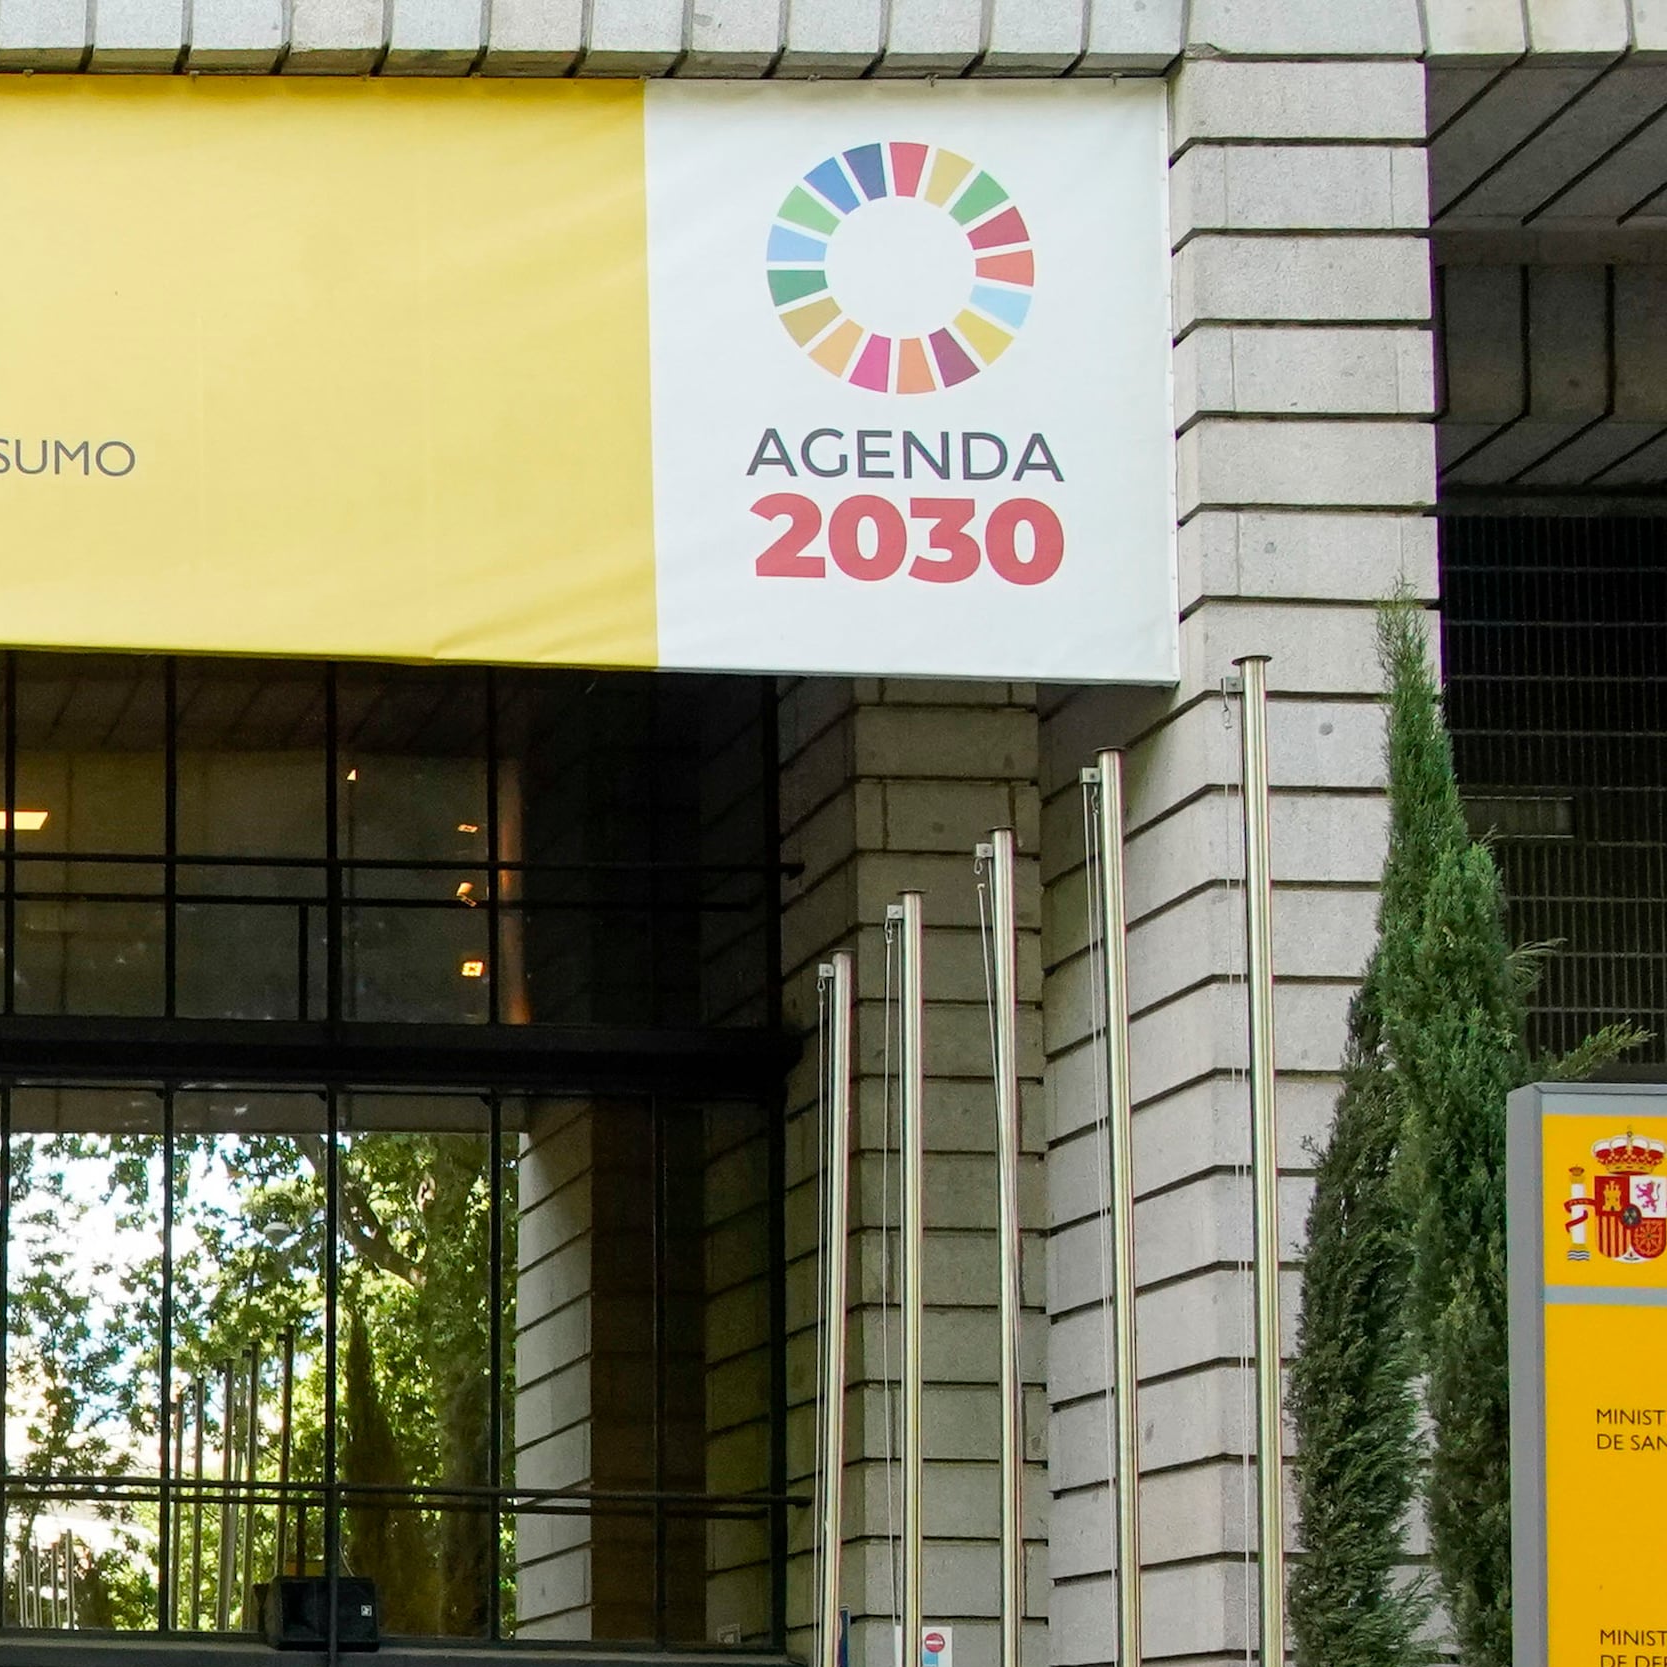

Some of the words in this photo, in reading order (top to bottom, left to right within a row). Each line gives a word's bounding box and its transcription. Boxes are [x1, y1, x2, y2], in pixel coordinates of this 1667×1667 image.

[746, 428, 1065, 482] AGENDA
[749, 493, 1065, 585] 2030
[1597, 1408, 1666, 1425] MINIST
[1597, 1433, 1624, 1450] DE
